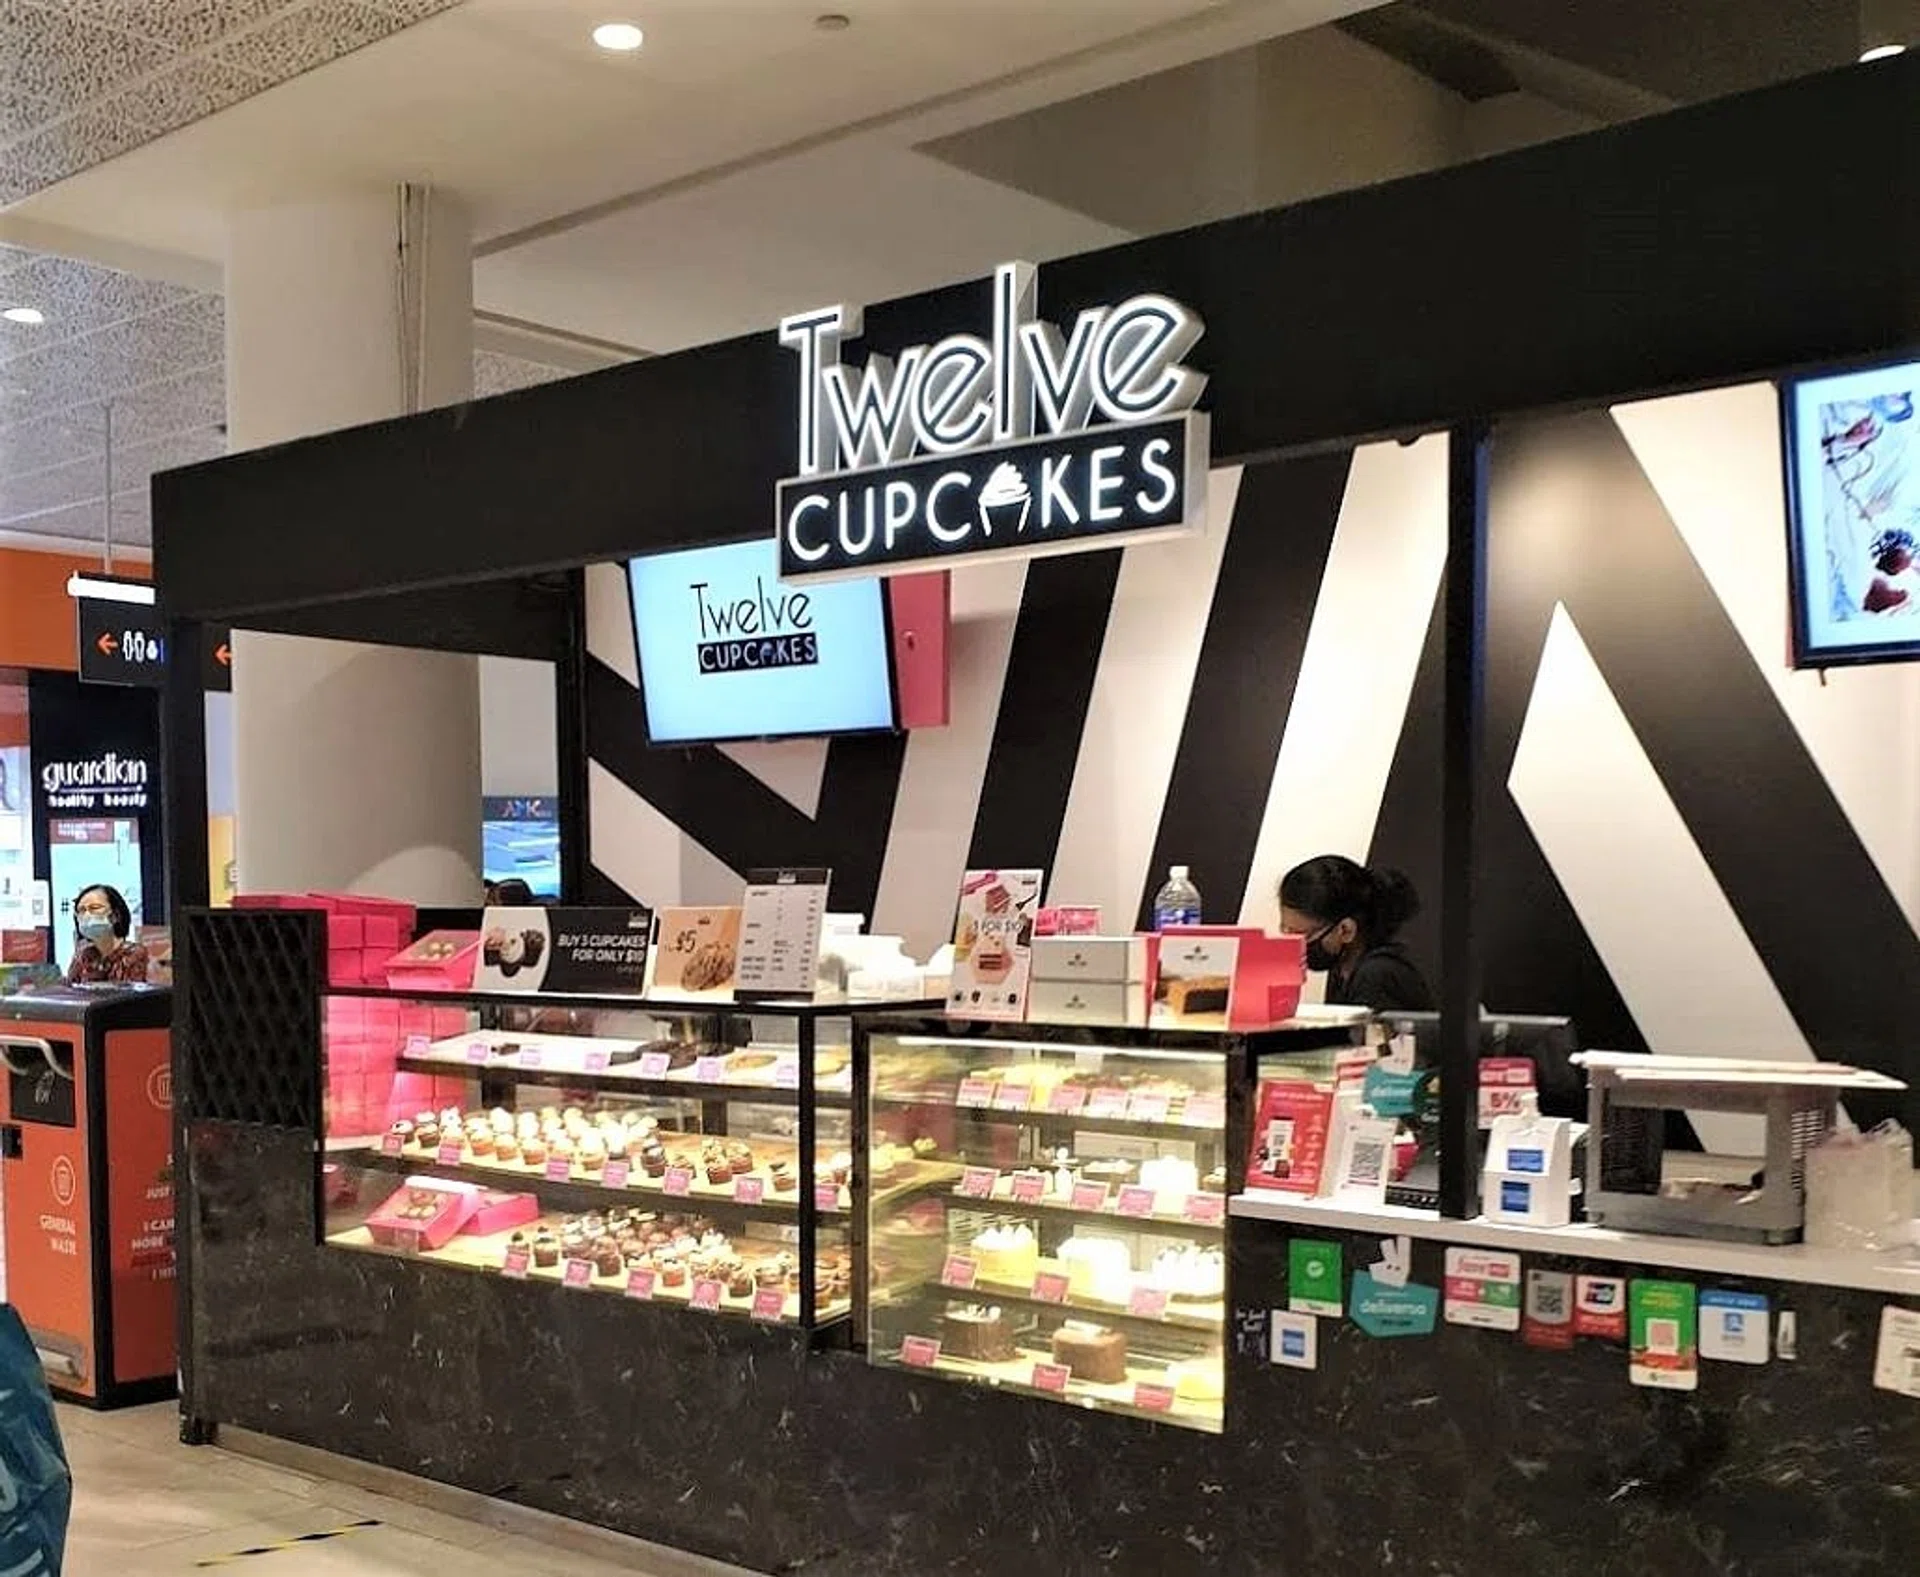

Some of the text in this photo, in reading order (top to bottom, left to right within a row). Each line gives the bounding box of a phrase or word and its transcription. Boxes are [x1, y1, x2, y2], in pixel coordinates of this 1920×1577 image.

[779, 262, 1192, 476] Twelve
[787, 438, 1177, 562] CUPCAKES
[690, 575, 813, 639] Twelve
[700, 635, 818, 670] CUPCAKES
[42, 752, 147, 792] guardian
[557, 933, 579, 947] BUY
[589, 934, 646, 948] CUPCAKES
[571, 948, 594, 961] FOR
[595, 948, 625, 962] ONLY
